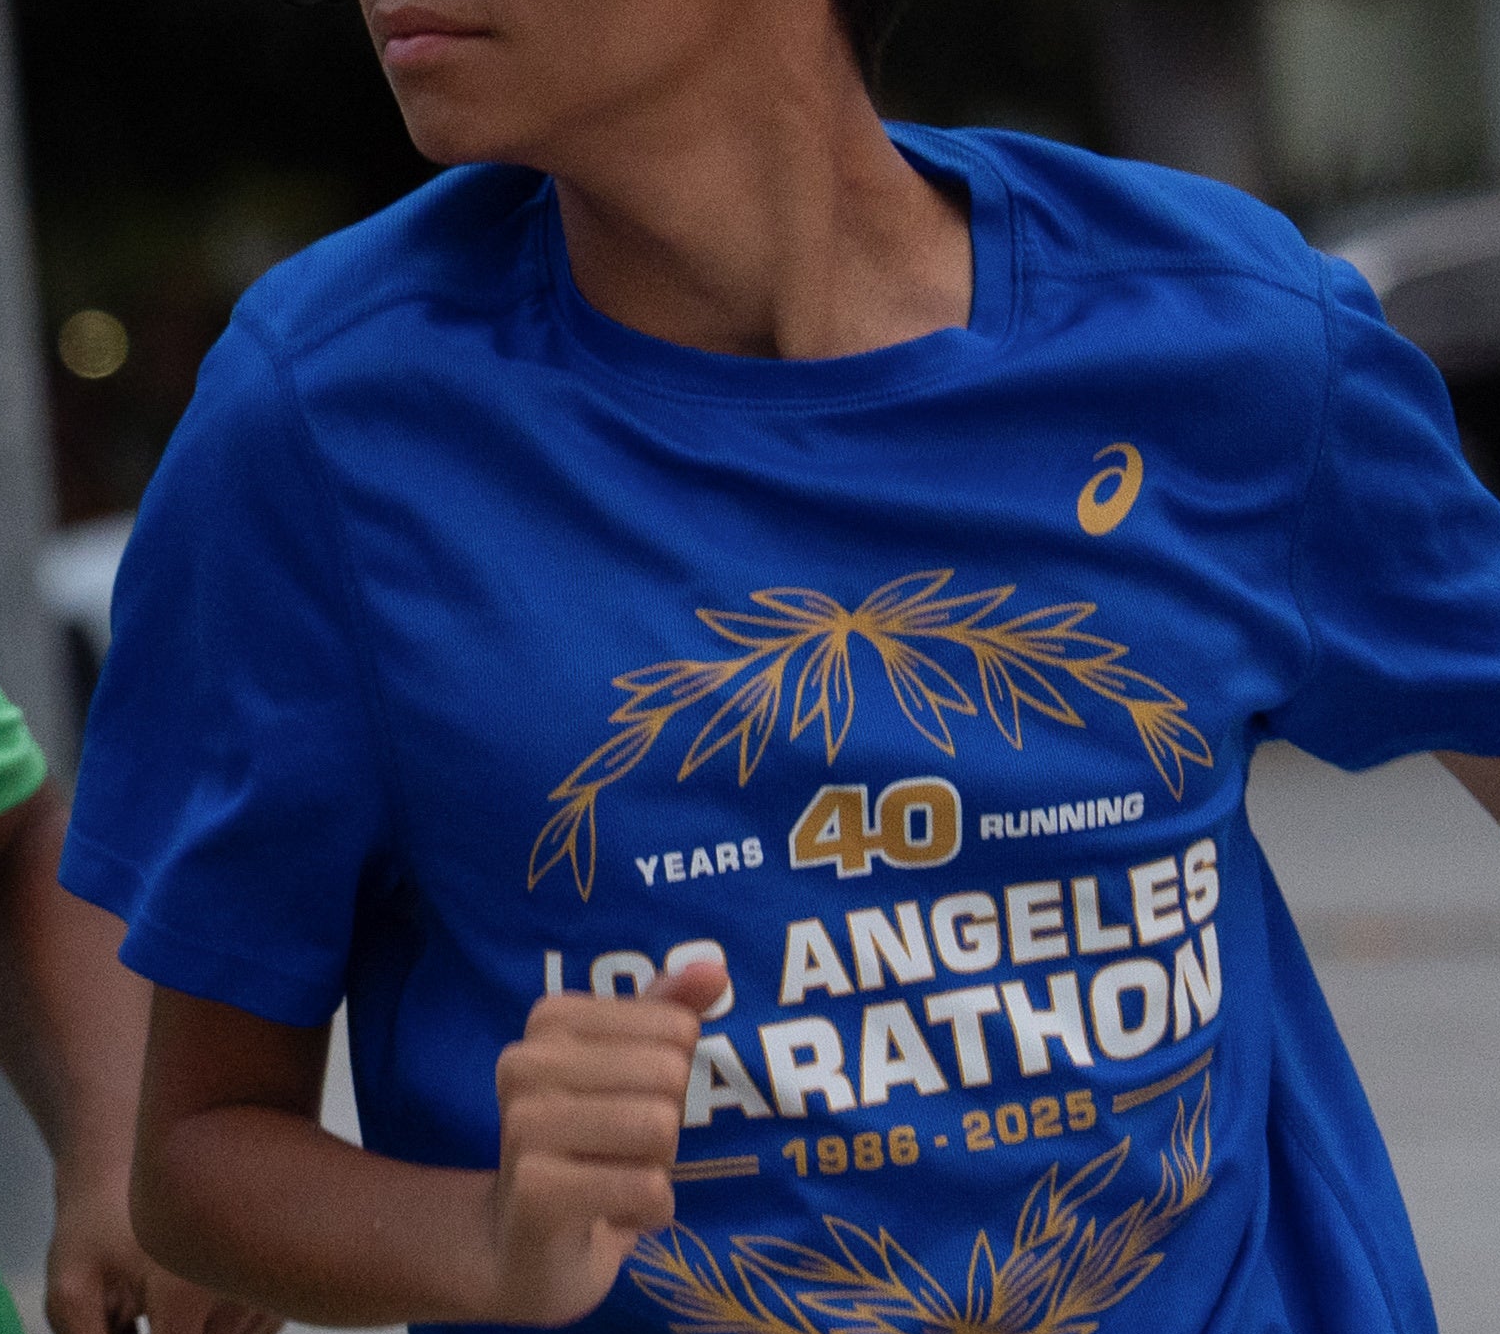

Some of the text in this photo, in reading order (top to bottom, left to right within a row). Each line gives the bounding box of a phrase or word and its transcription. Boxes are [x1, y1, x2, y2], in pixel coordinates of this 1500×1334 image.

[634, 776, 1146, 887] YEARS 40 RUNNING
[778, 837, 1223, 1005] ANGELES
[682, 922, 1224, 1128] ARATHON
[780, 1125, 921, 1179] 1986
[962, 1090, 1098, 1151] 2025
